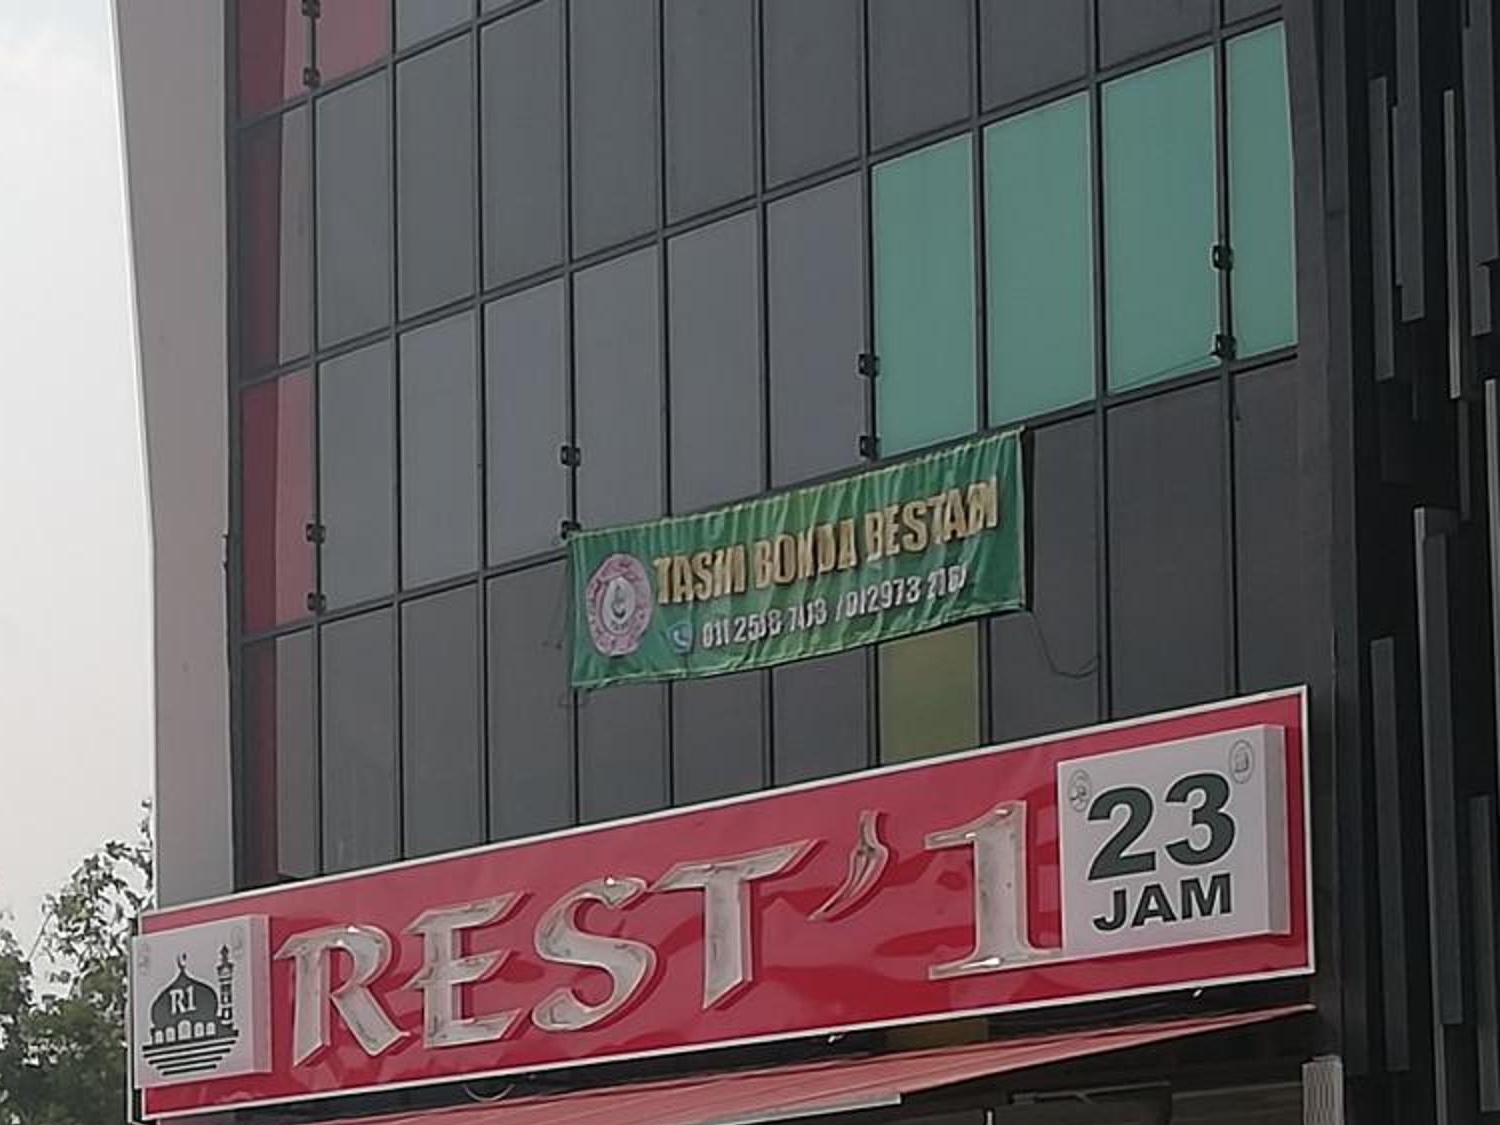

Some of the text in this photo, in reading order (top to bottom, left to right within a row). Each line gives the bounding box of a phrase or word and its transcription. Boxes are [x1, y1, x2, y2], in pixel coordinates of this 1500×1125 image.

[1087, 772, 1236, 881] 23
[1092, 872, 1232, 933] JAM
[169, 985, 197, 1016] R1
